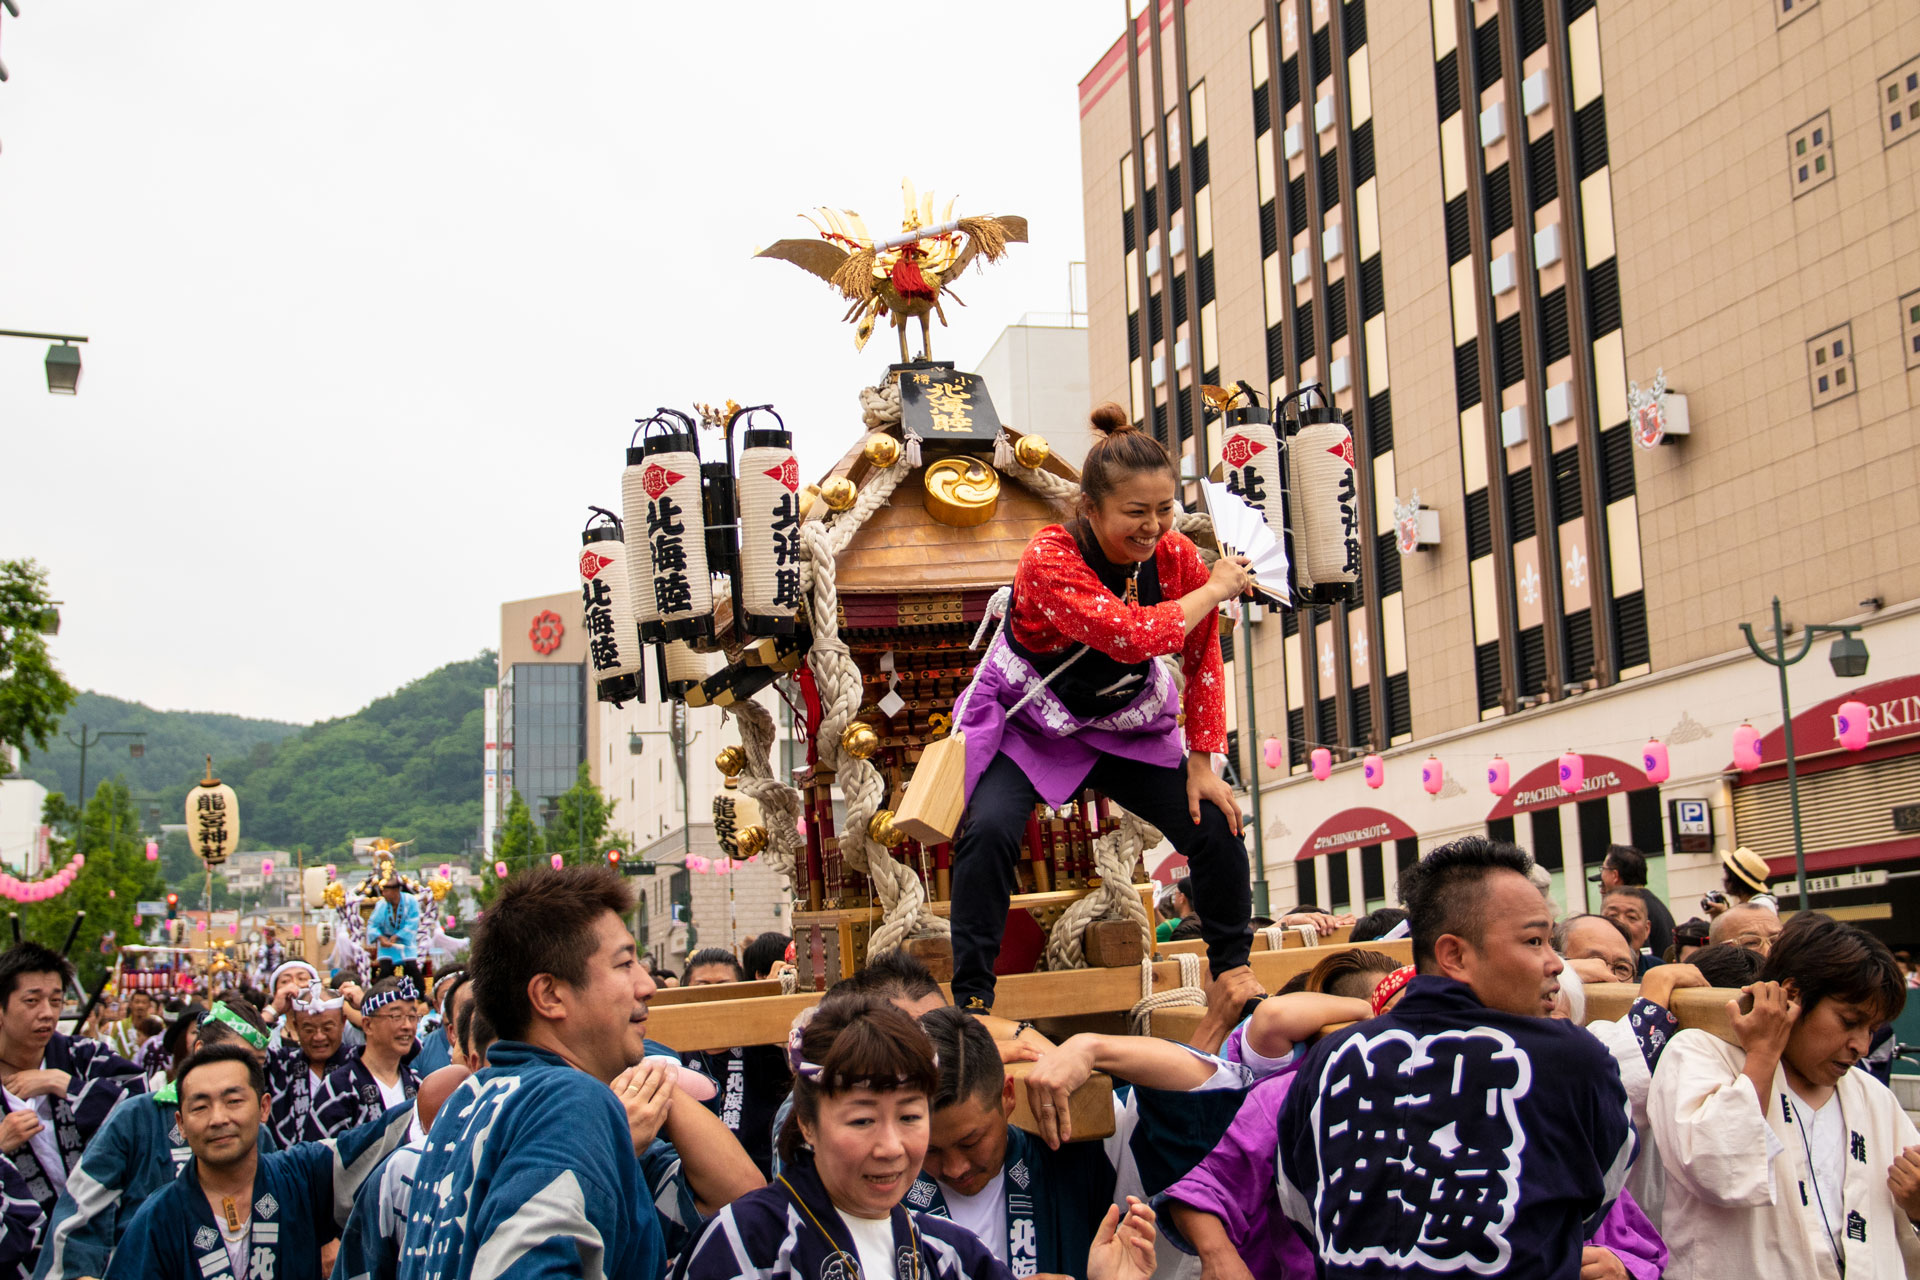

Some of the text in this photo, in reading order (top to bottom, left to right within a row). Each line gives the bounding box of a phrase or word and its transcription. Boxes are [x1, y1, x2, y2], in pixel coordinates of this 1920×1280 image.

[925, 383, 974, 433] 北海睦
[646, 496, 692, 615] 北海睦
[582, 578, 621, 672] 北海睦
[1831, 695, 1920, 741] RKIN
[1522, 773, 1608, 804] PACHINSLOT
